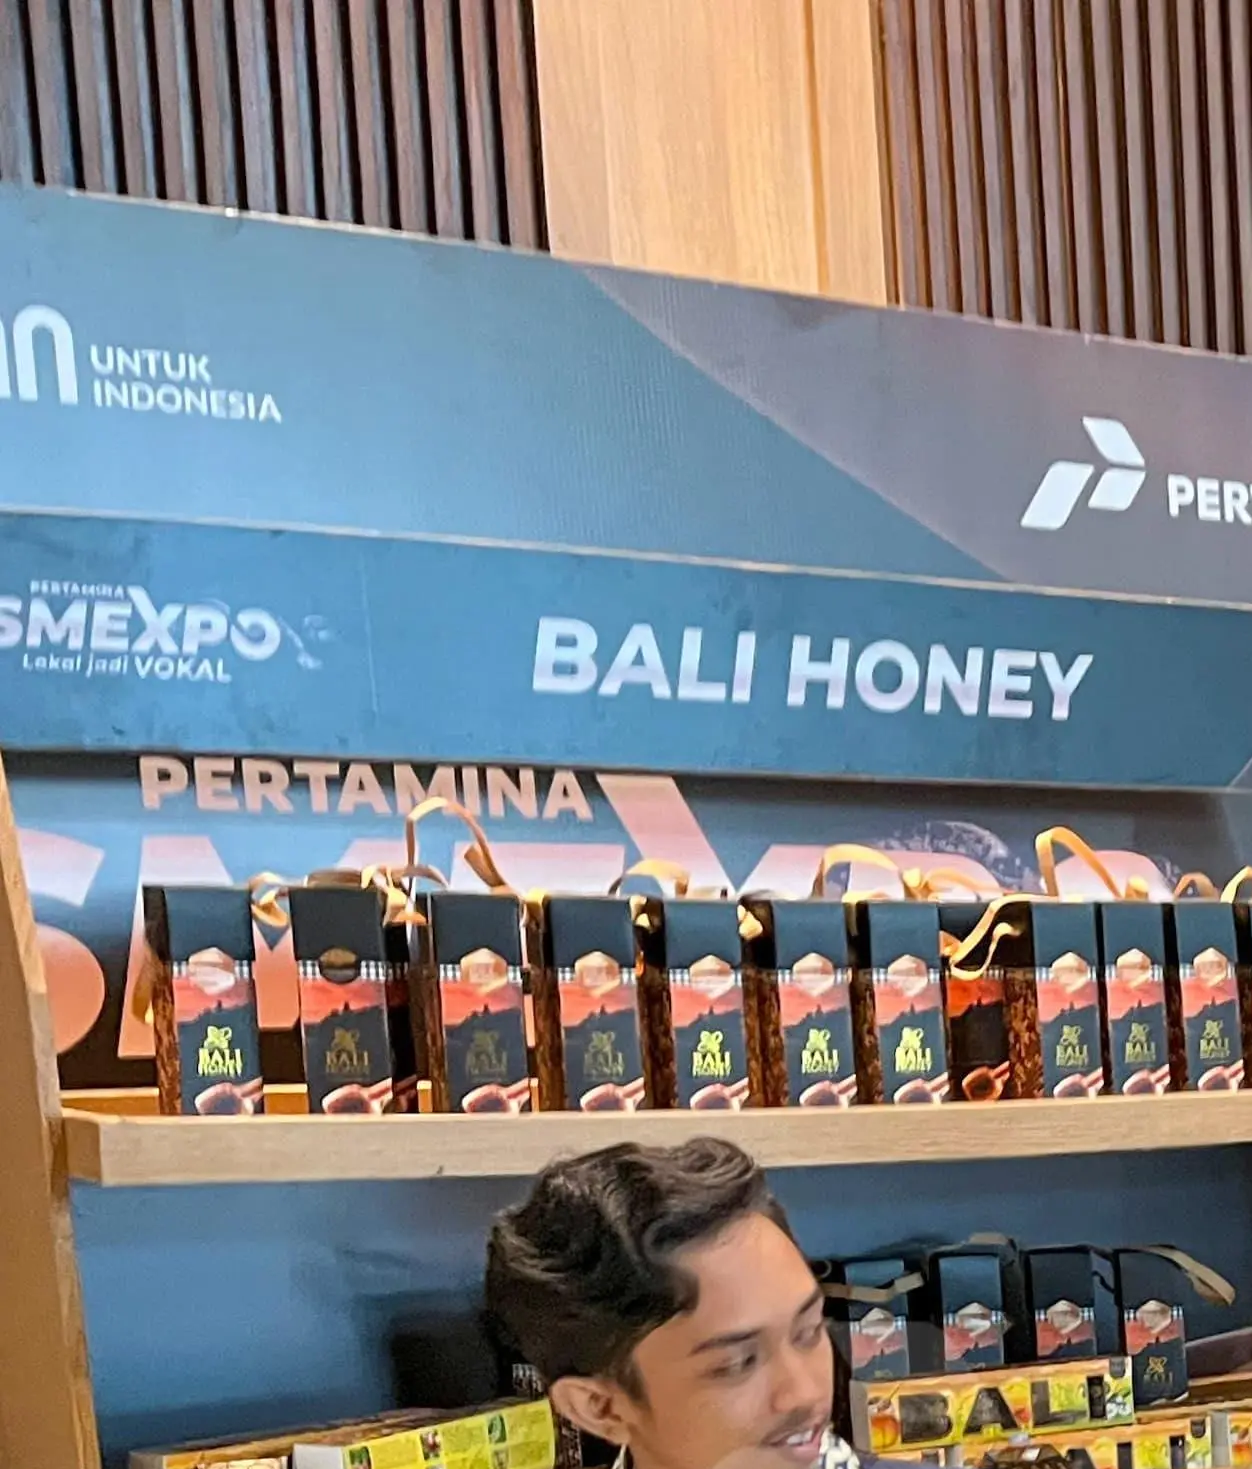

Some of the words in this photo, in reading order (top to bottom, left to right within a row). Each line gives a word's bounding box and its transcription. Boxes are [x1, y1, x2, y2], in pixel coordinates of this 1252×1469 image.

[90, 344, 211, 385] UNTUK
[93, 378, 282, 424] INDONESIA
[29, 579, 125, 599] PERTAMINA
[133, 655, 232, 684] VOKAL
[532, 616, 755, 704] BALI
[785, 633, 1094, 722] HONEY
[139, 755, 594, 822] PERTAMINA
[1056, 1045, 1088, 1058] BALI
[1125, 1041, 1156, 1055] BALI
